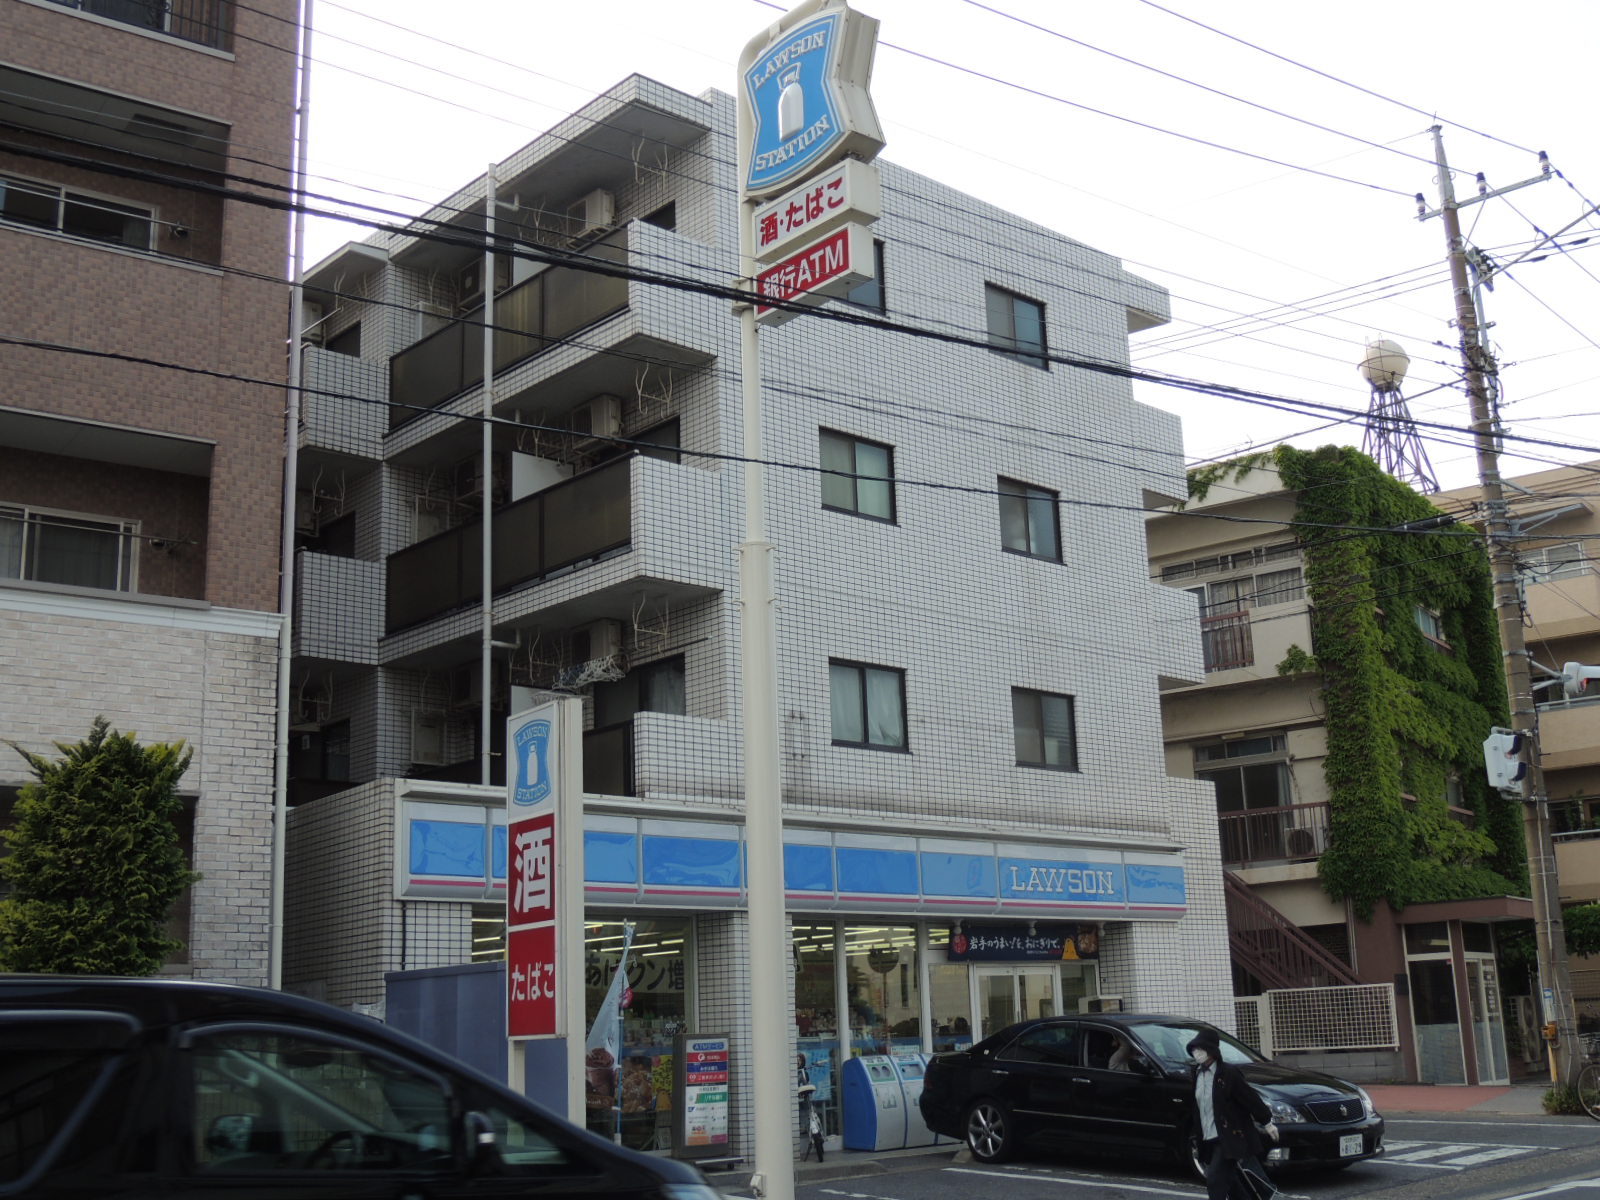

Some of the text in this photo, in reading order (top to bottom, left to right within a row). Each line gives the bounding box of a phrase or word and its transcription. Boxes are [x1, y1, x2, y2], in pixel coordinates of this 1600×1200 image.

[753, 30, 826, 89] LAWSON
[755, 115, 830, 171] STATION
[760, 176, 845, 246] 酒・たばこ
[763, 239, 844, 303] 銀行ATM
[517, 726, 548, 746] LAWSON
[516, 780, 549, 801] STATION
[513, 826, 552, 913] 酒
[1010, 866, 1115, 895] LAWSON
[511, 961, 554, 1003] たばこ
